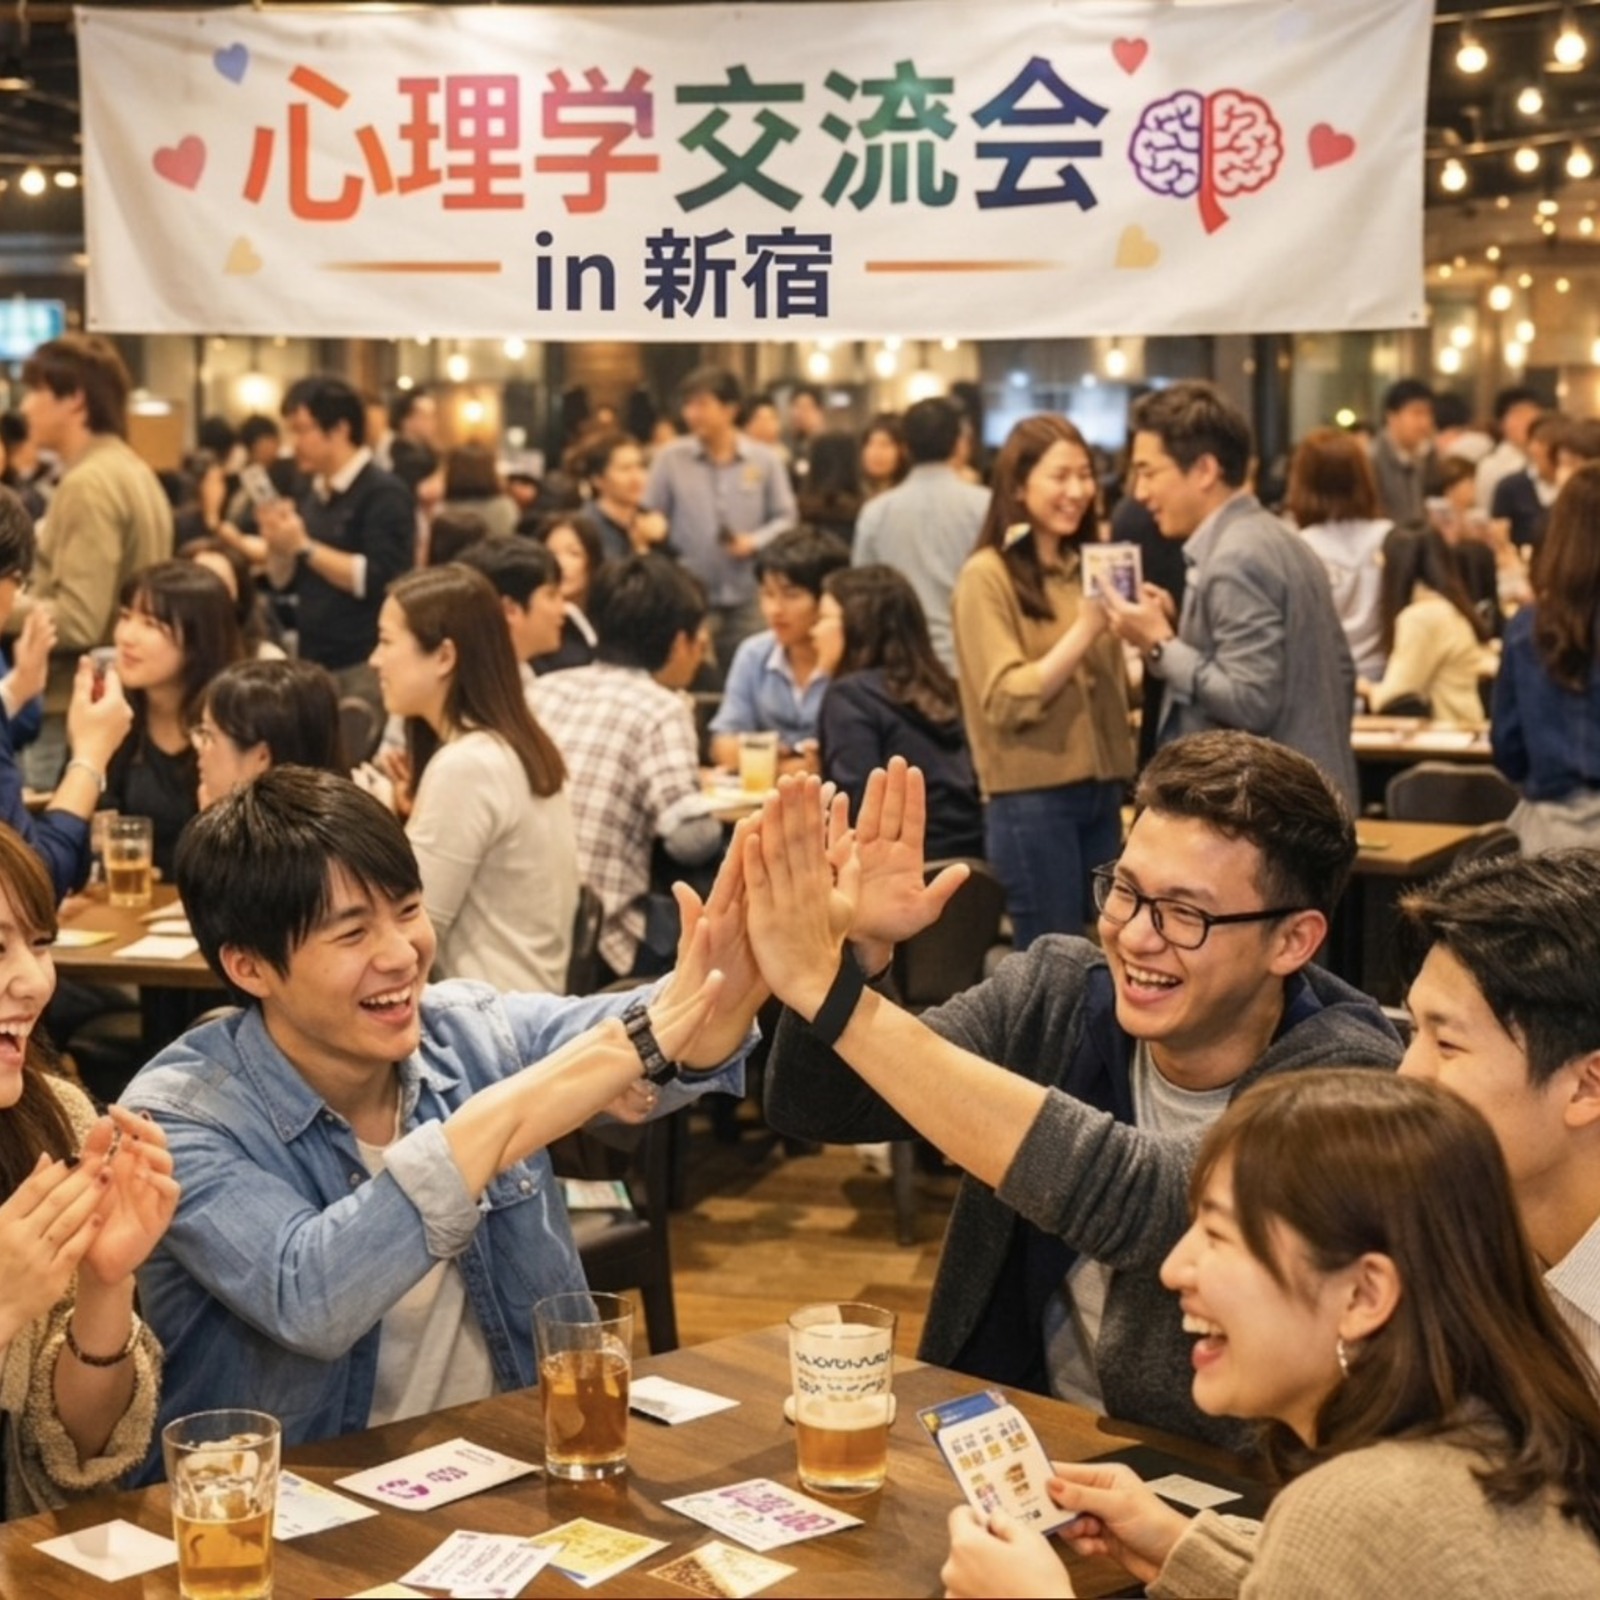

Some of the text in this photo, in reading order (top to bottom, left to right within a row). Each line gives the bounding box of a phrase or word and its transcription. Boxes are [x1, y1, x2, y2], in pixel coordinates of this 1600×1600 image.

[242, 56, 1110, 222] 心理学交流会
[535, 227, 834, 319] in 新宿
